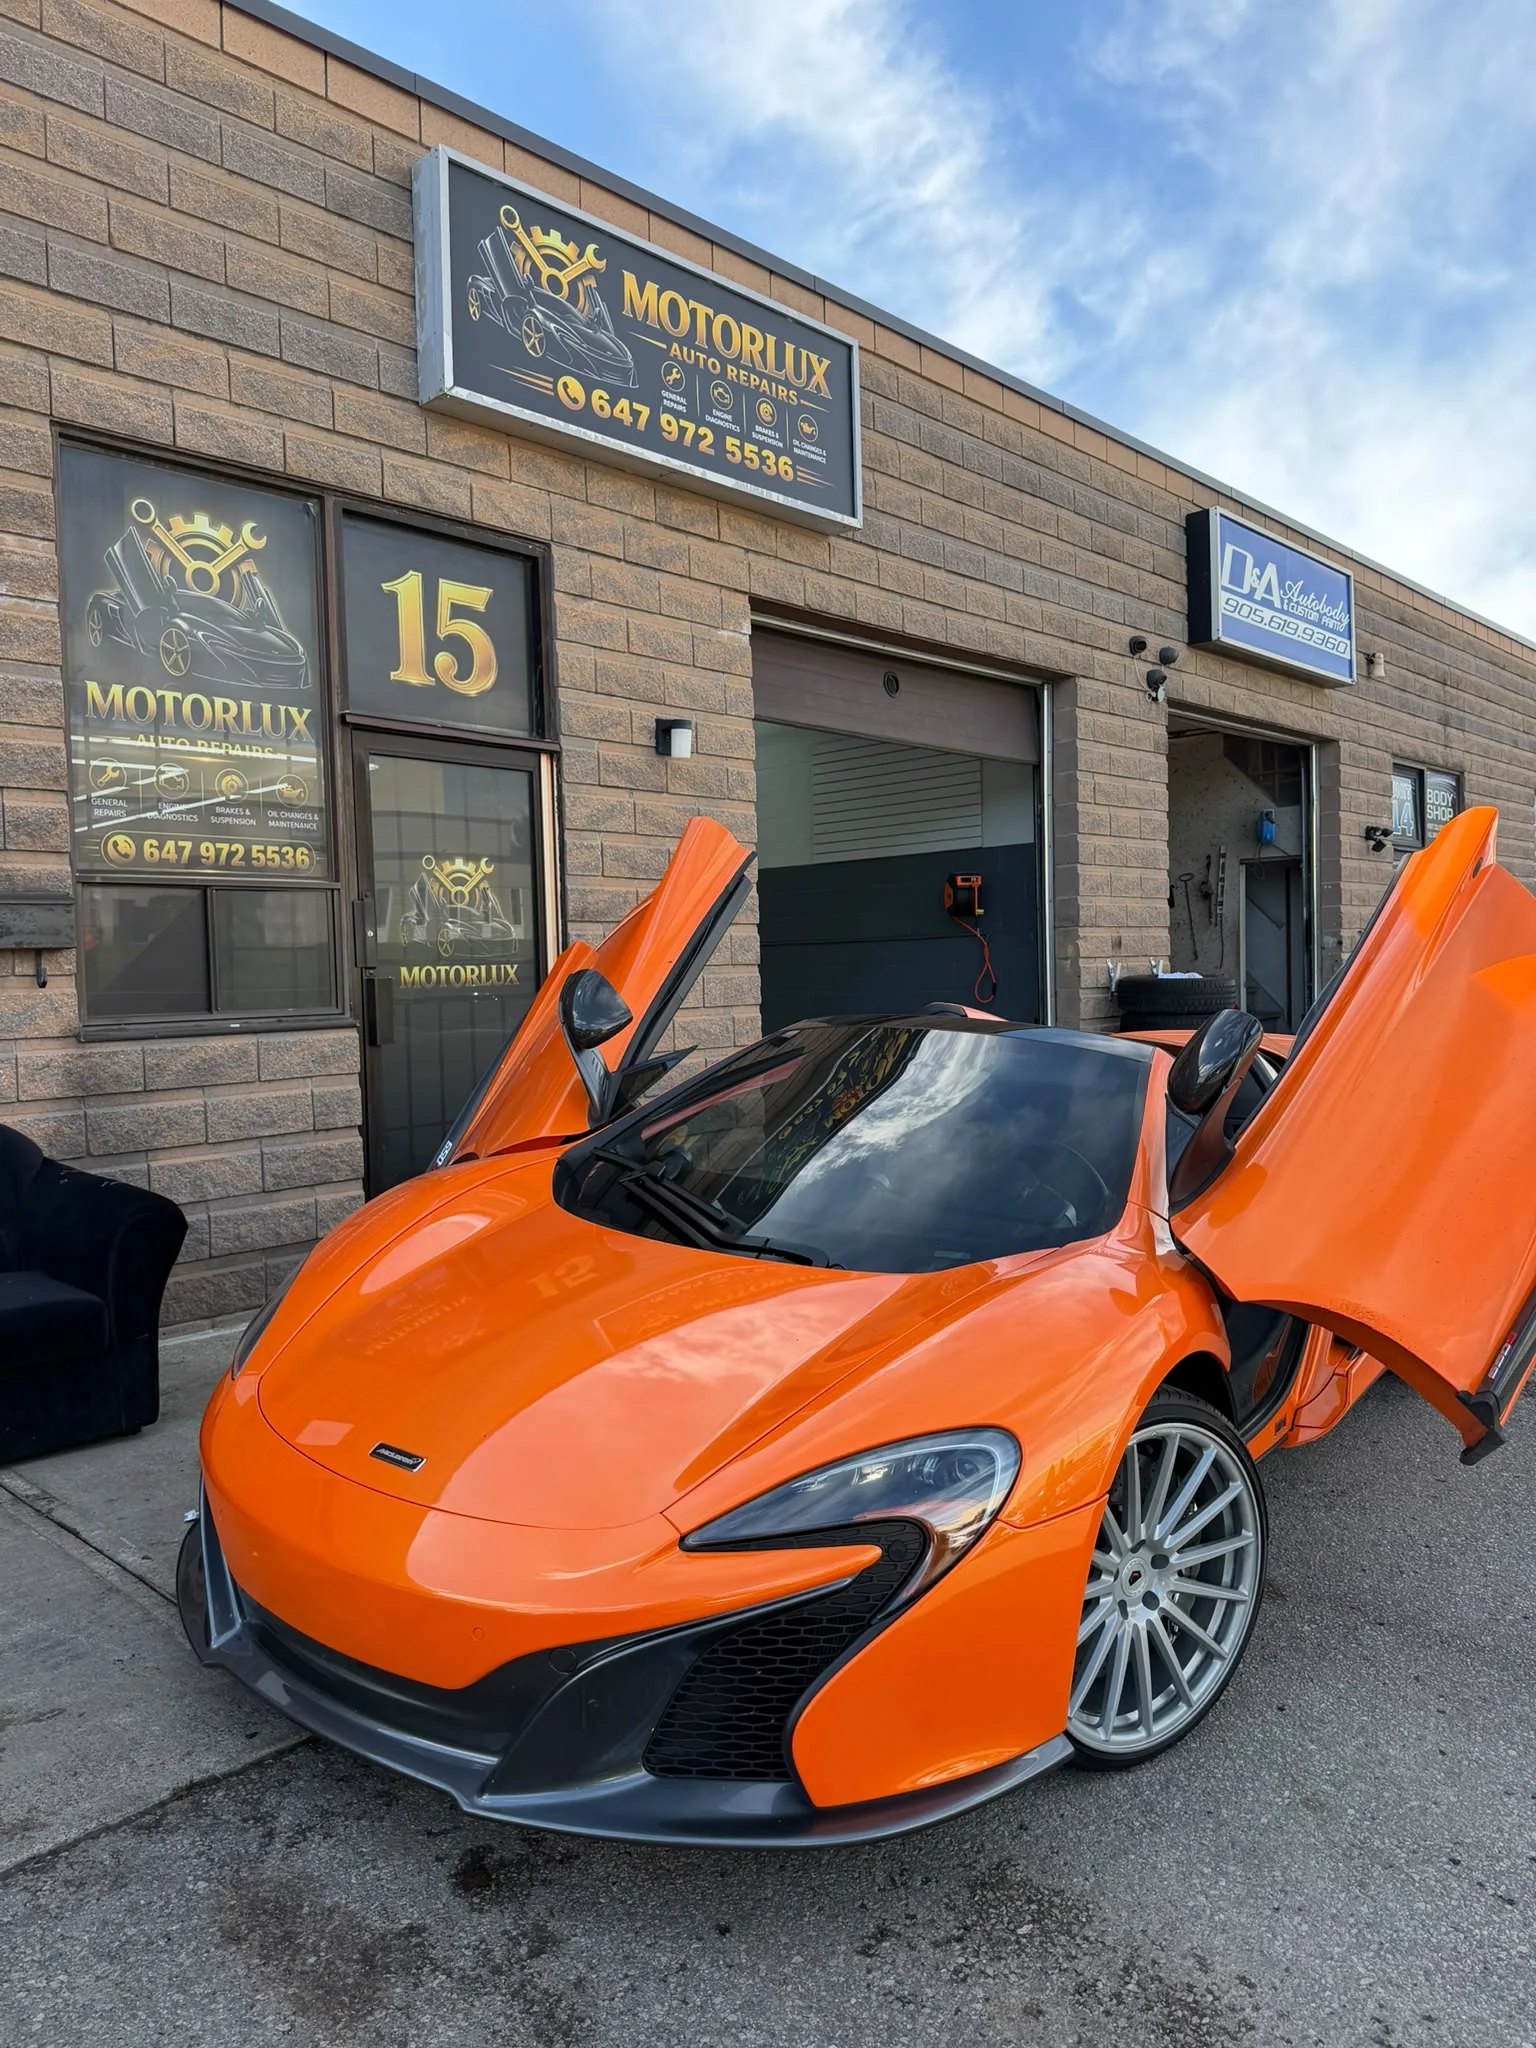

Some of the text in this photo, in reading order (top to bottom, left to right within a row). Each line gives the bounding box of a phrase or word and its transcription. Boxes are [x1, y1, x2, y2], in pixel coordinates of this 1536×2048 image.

[622, 269, 832, 399] MOTORLUX
[669, 342, 798, 406] AUTO REPAIRS
[661, 390, 687, 405] GENERAL
[663, 399, 687, 413] REPAIRS
[705, 414, 740, 433] DIAGNOSTICS
[712, 409, 733, 422] ENGINE
[591, 388, 794, 482] 647 972 5536
[755, 425, 775, 437] BRAKES
[752, 432, 784, 448] SUSPENSION
[800, 442, 822, 455] CHANGES
[793, 447, 827, 464] MAINTENANCE
[1221, 542, 1282, 609] D&A
[1280, 580, 1350, 632] Autobody
[1289, 602, 1319, 622] CUSTOM
[380, 569, 498, 697] 15
[1223, 597, 1348, 655] 905.619.9360
[84, 680, 314, 742] MOTORLUX
[91, 798, 128, 808] GENERAL
[1427, 788, 1453, 807] BODY
[94, 808, 127, 818] REPAIRS
[147, 811, 199, 823] DIAGNOSTICS
[215, 806, 251, 816] BRAKES &
[267, 810, 319, 821] OIL CHANGES &
[1427, 804, 1454, 822] SHOP
[210, 816, 256, 826] SUSPENSION
[268, 820, 318, 830] MAINTENANCE
[143, 838, 310, 870] 647 972 5536
[400, 963, 521, 989] MOTORLUX
